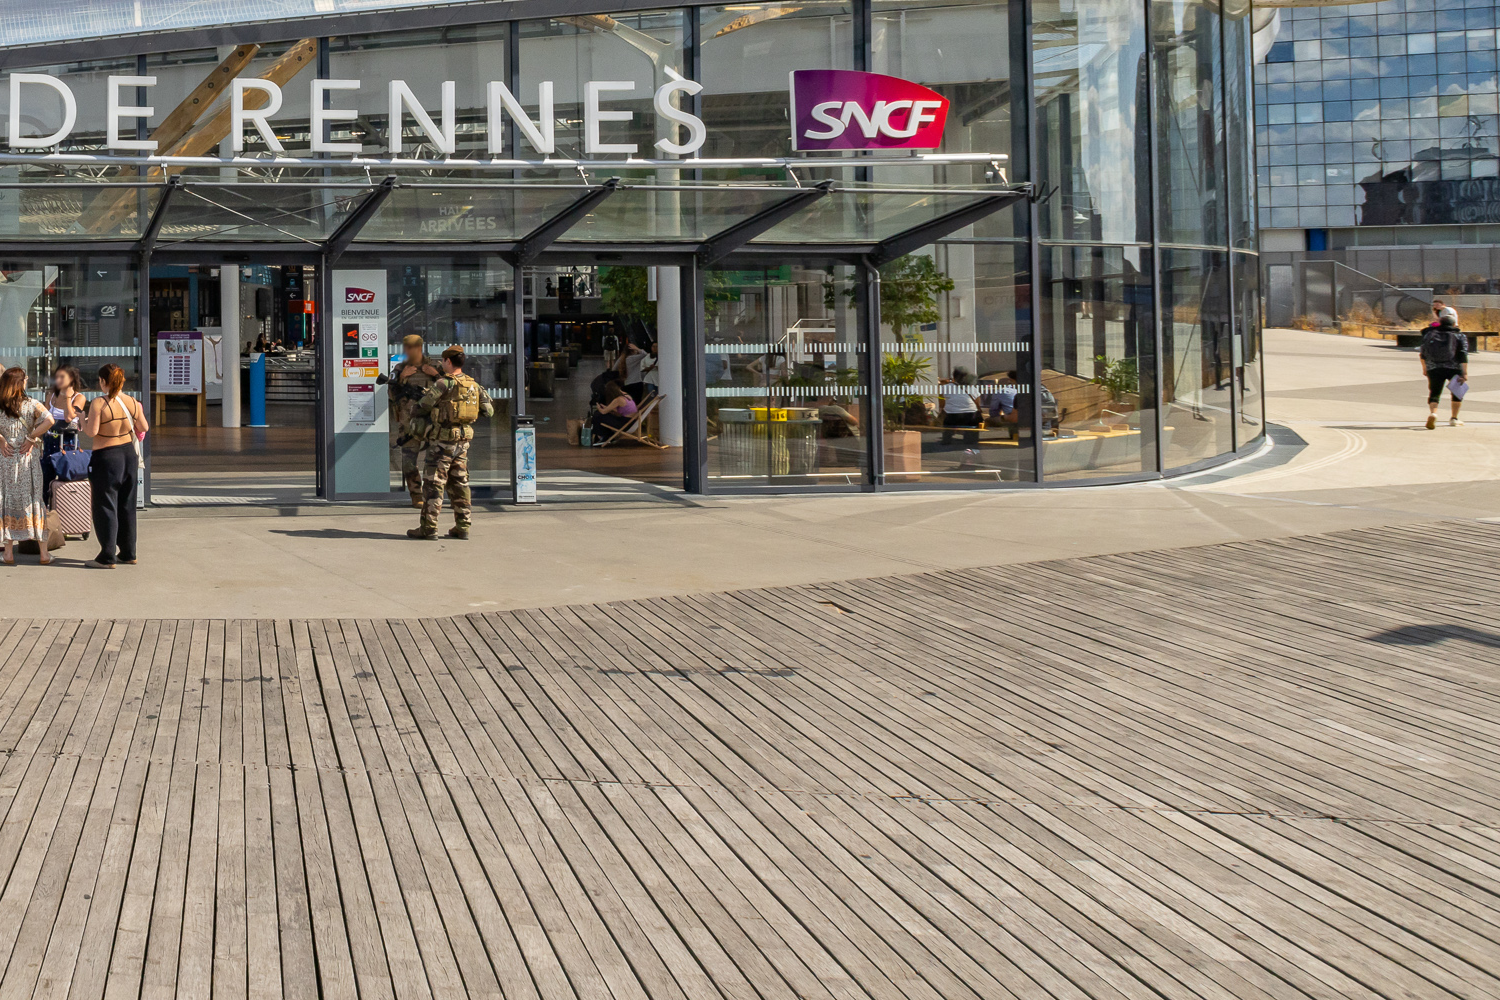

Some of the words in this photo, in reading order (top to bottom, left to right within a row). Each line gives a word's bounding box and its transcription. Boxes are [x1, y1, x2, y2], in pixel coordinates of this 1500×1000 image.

[8, 73, 159, 150] DE
[230, 77, 707, 155] RENNES
[803, 99, 943, 141] SNCF
[439, 205, 469, 216] HAL
[419, 214, 497, 234] ARRIVÉES
[347, 293, 373, 302] SNCF
